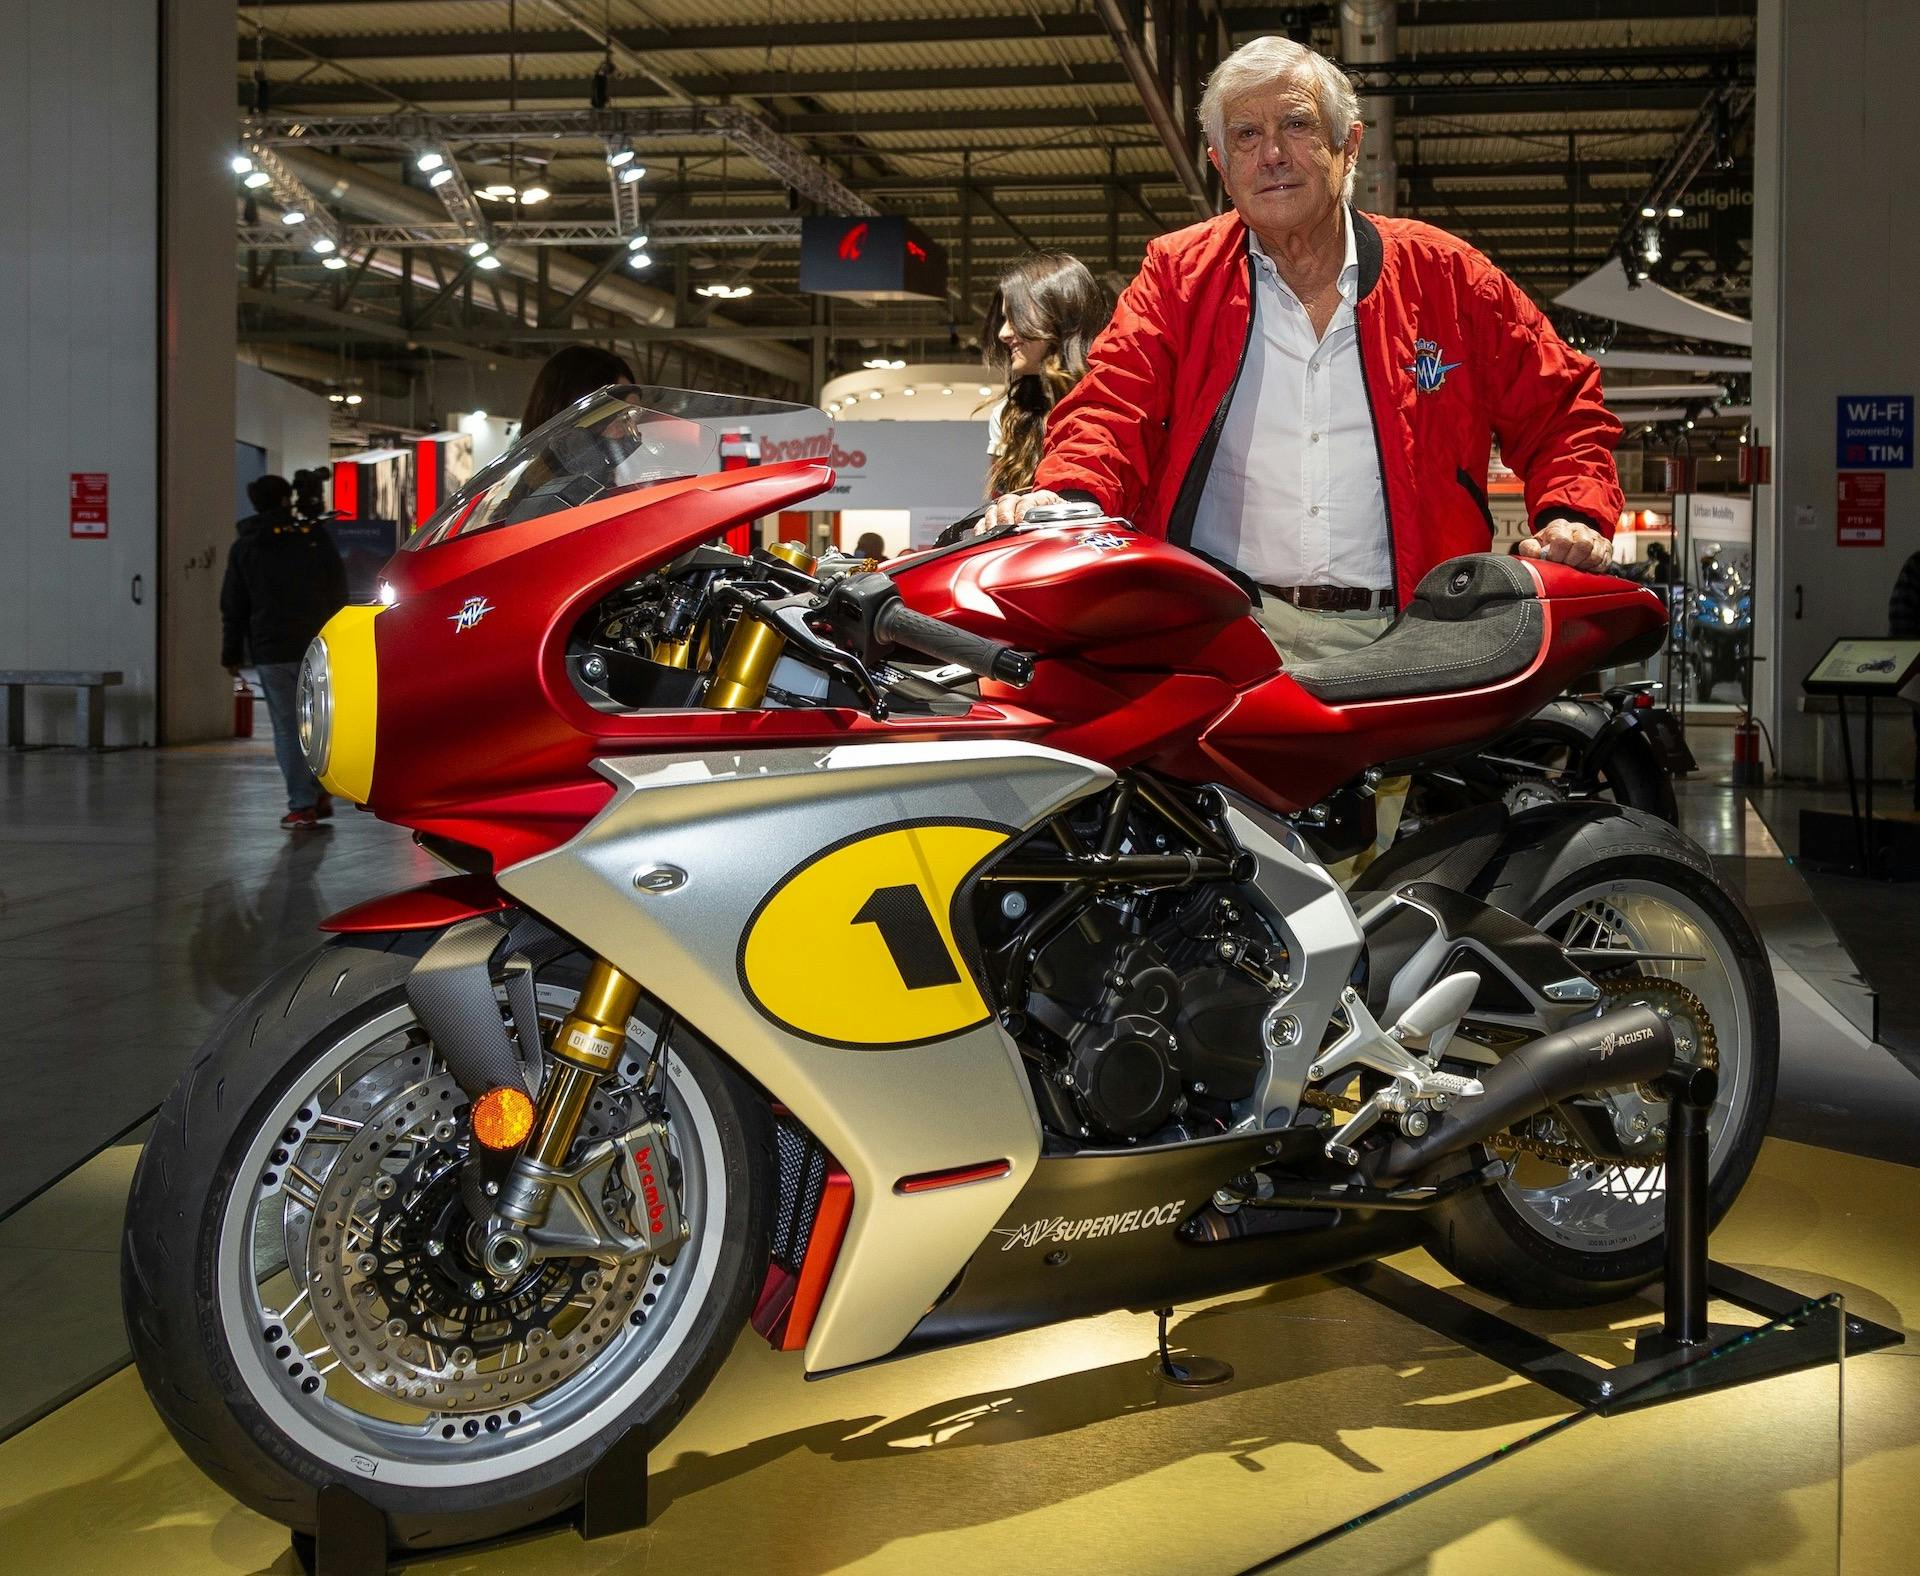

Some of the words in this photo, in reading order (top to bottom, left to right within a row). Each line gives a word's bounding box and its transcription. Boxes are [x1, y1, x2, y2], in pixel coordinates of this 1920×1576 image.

[1684, 188, 1755, 211] adiglio
[1848, 403, 1905, 421] Wi-Fi
[1846, 427, 1889, 438] powered
[1891, 427, 1904, 439] by
[1868, 446, 1904, 462] TIM
[850, 883, 962, 991] 1
[630, 1024, 647, 1037] DOT
[1618, 1027, 1655, 1047] AGUSTA
[635, 1147, 666, 1233] brembo
[1051, 1200, 1186, 1242] SUPERVELOCE
